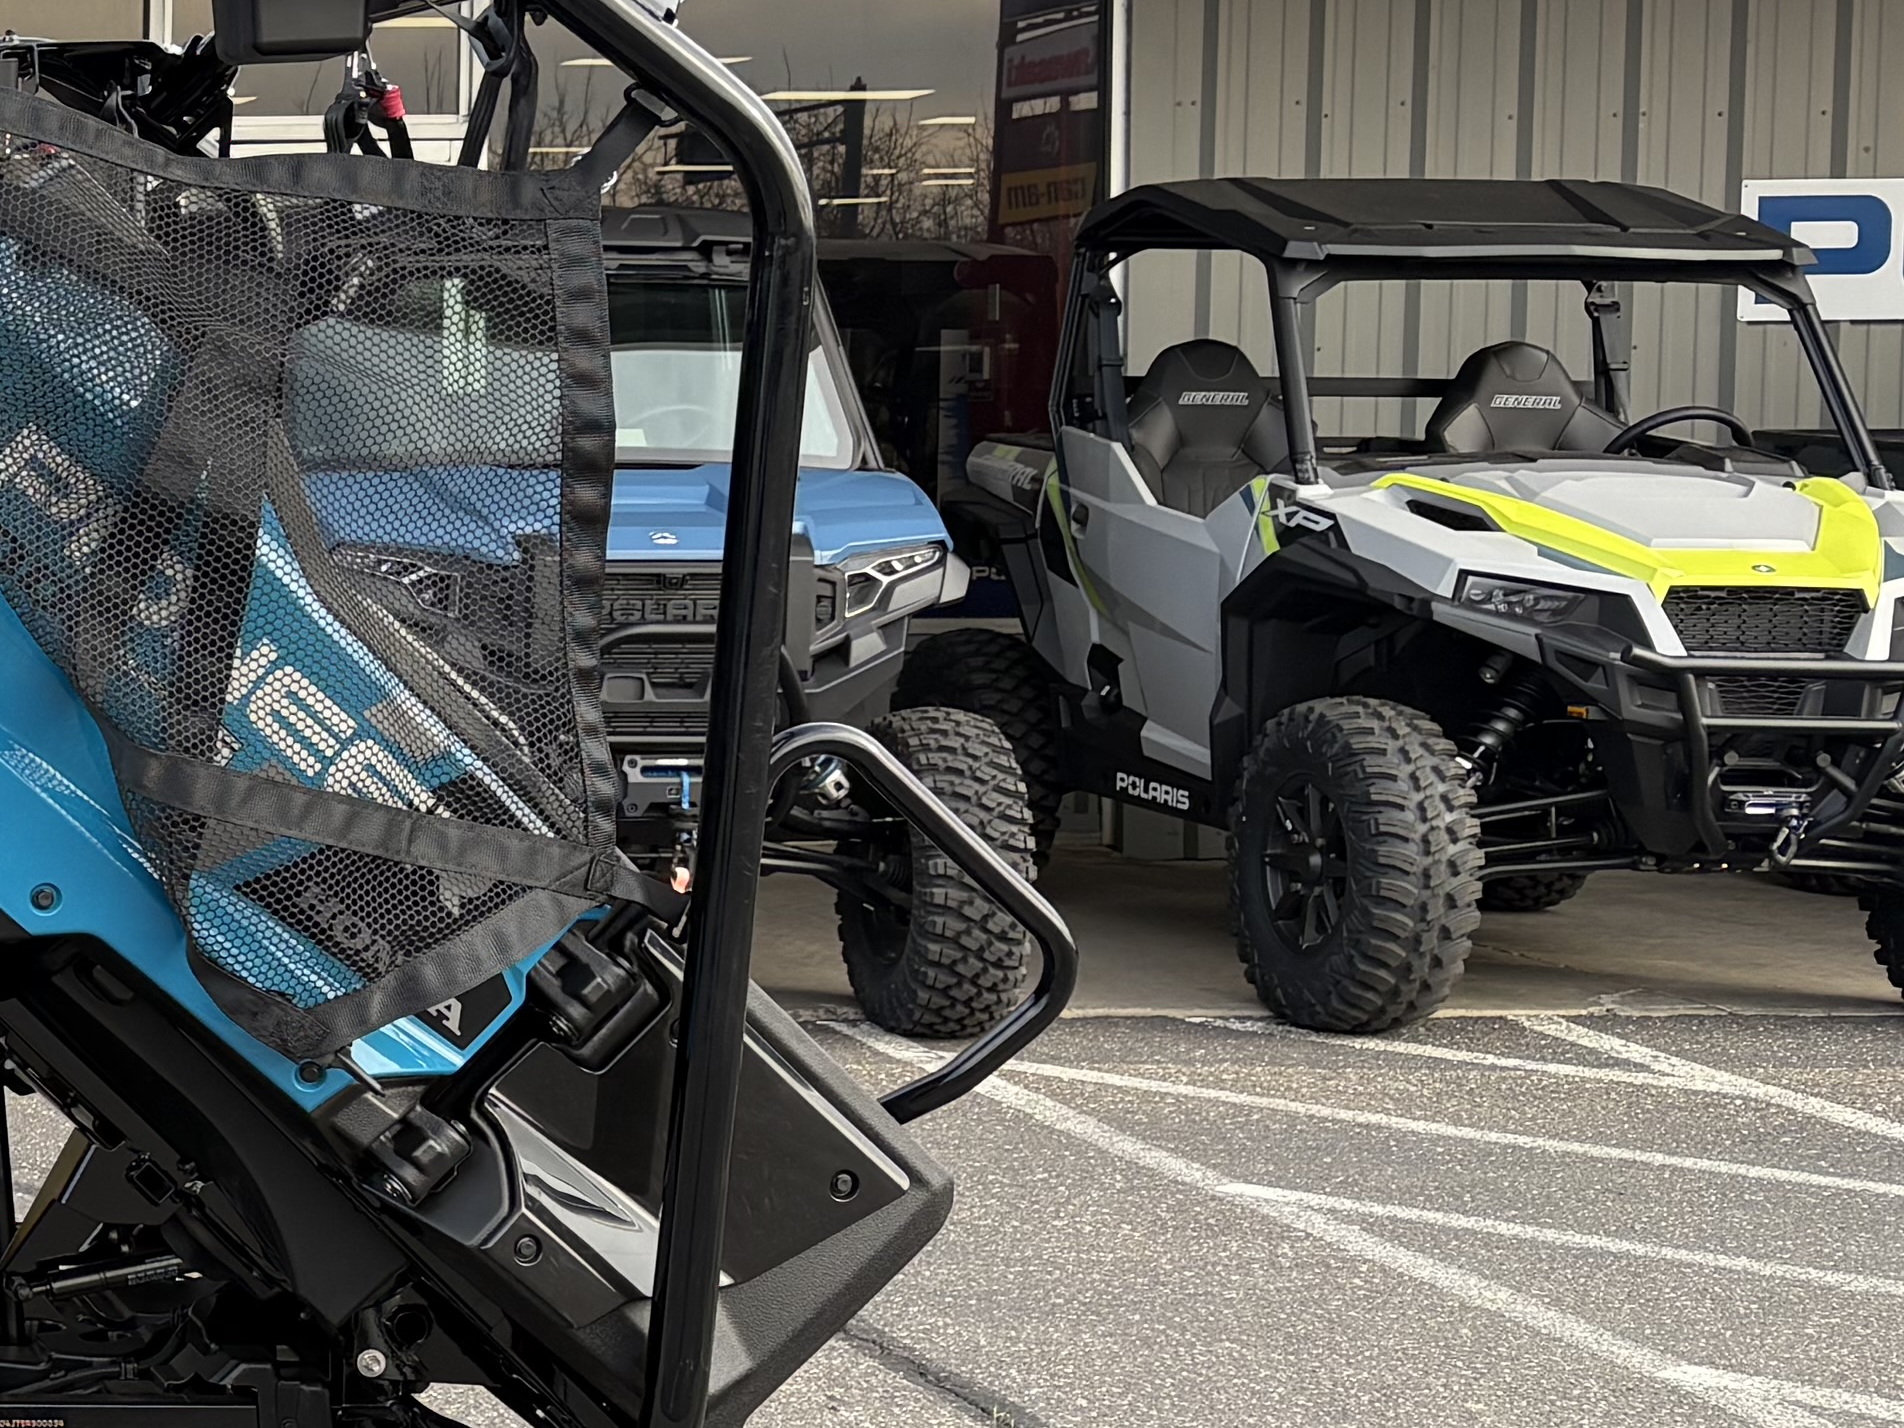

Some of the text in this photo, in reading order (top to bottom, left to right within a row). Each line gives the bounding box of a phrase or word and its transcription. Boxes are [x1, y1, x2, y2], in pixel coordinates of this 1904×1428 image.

[1754, 195, 1904, 306] P
[1178, 390, 1249, 405] GENERAL
[1490, 394, 1561, 410] GENERAL
[1263, 498, 1335, 533] XP
[1116, 771, 1191, 811] POLARIS
